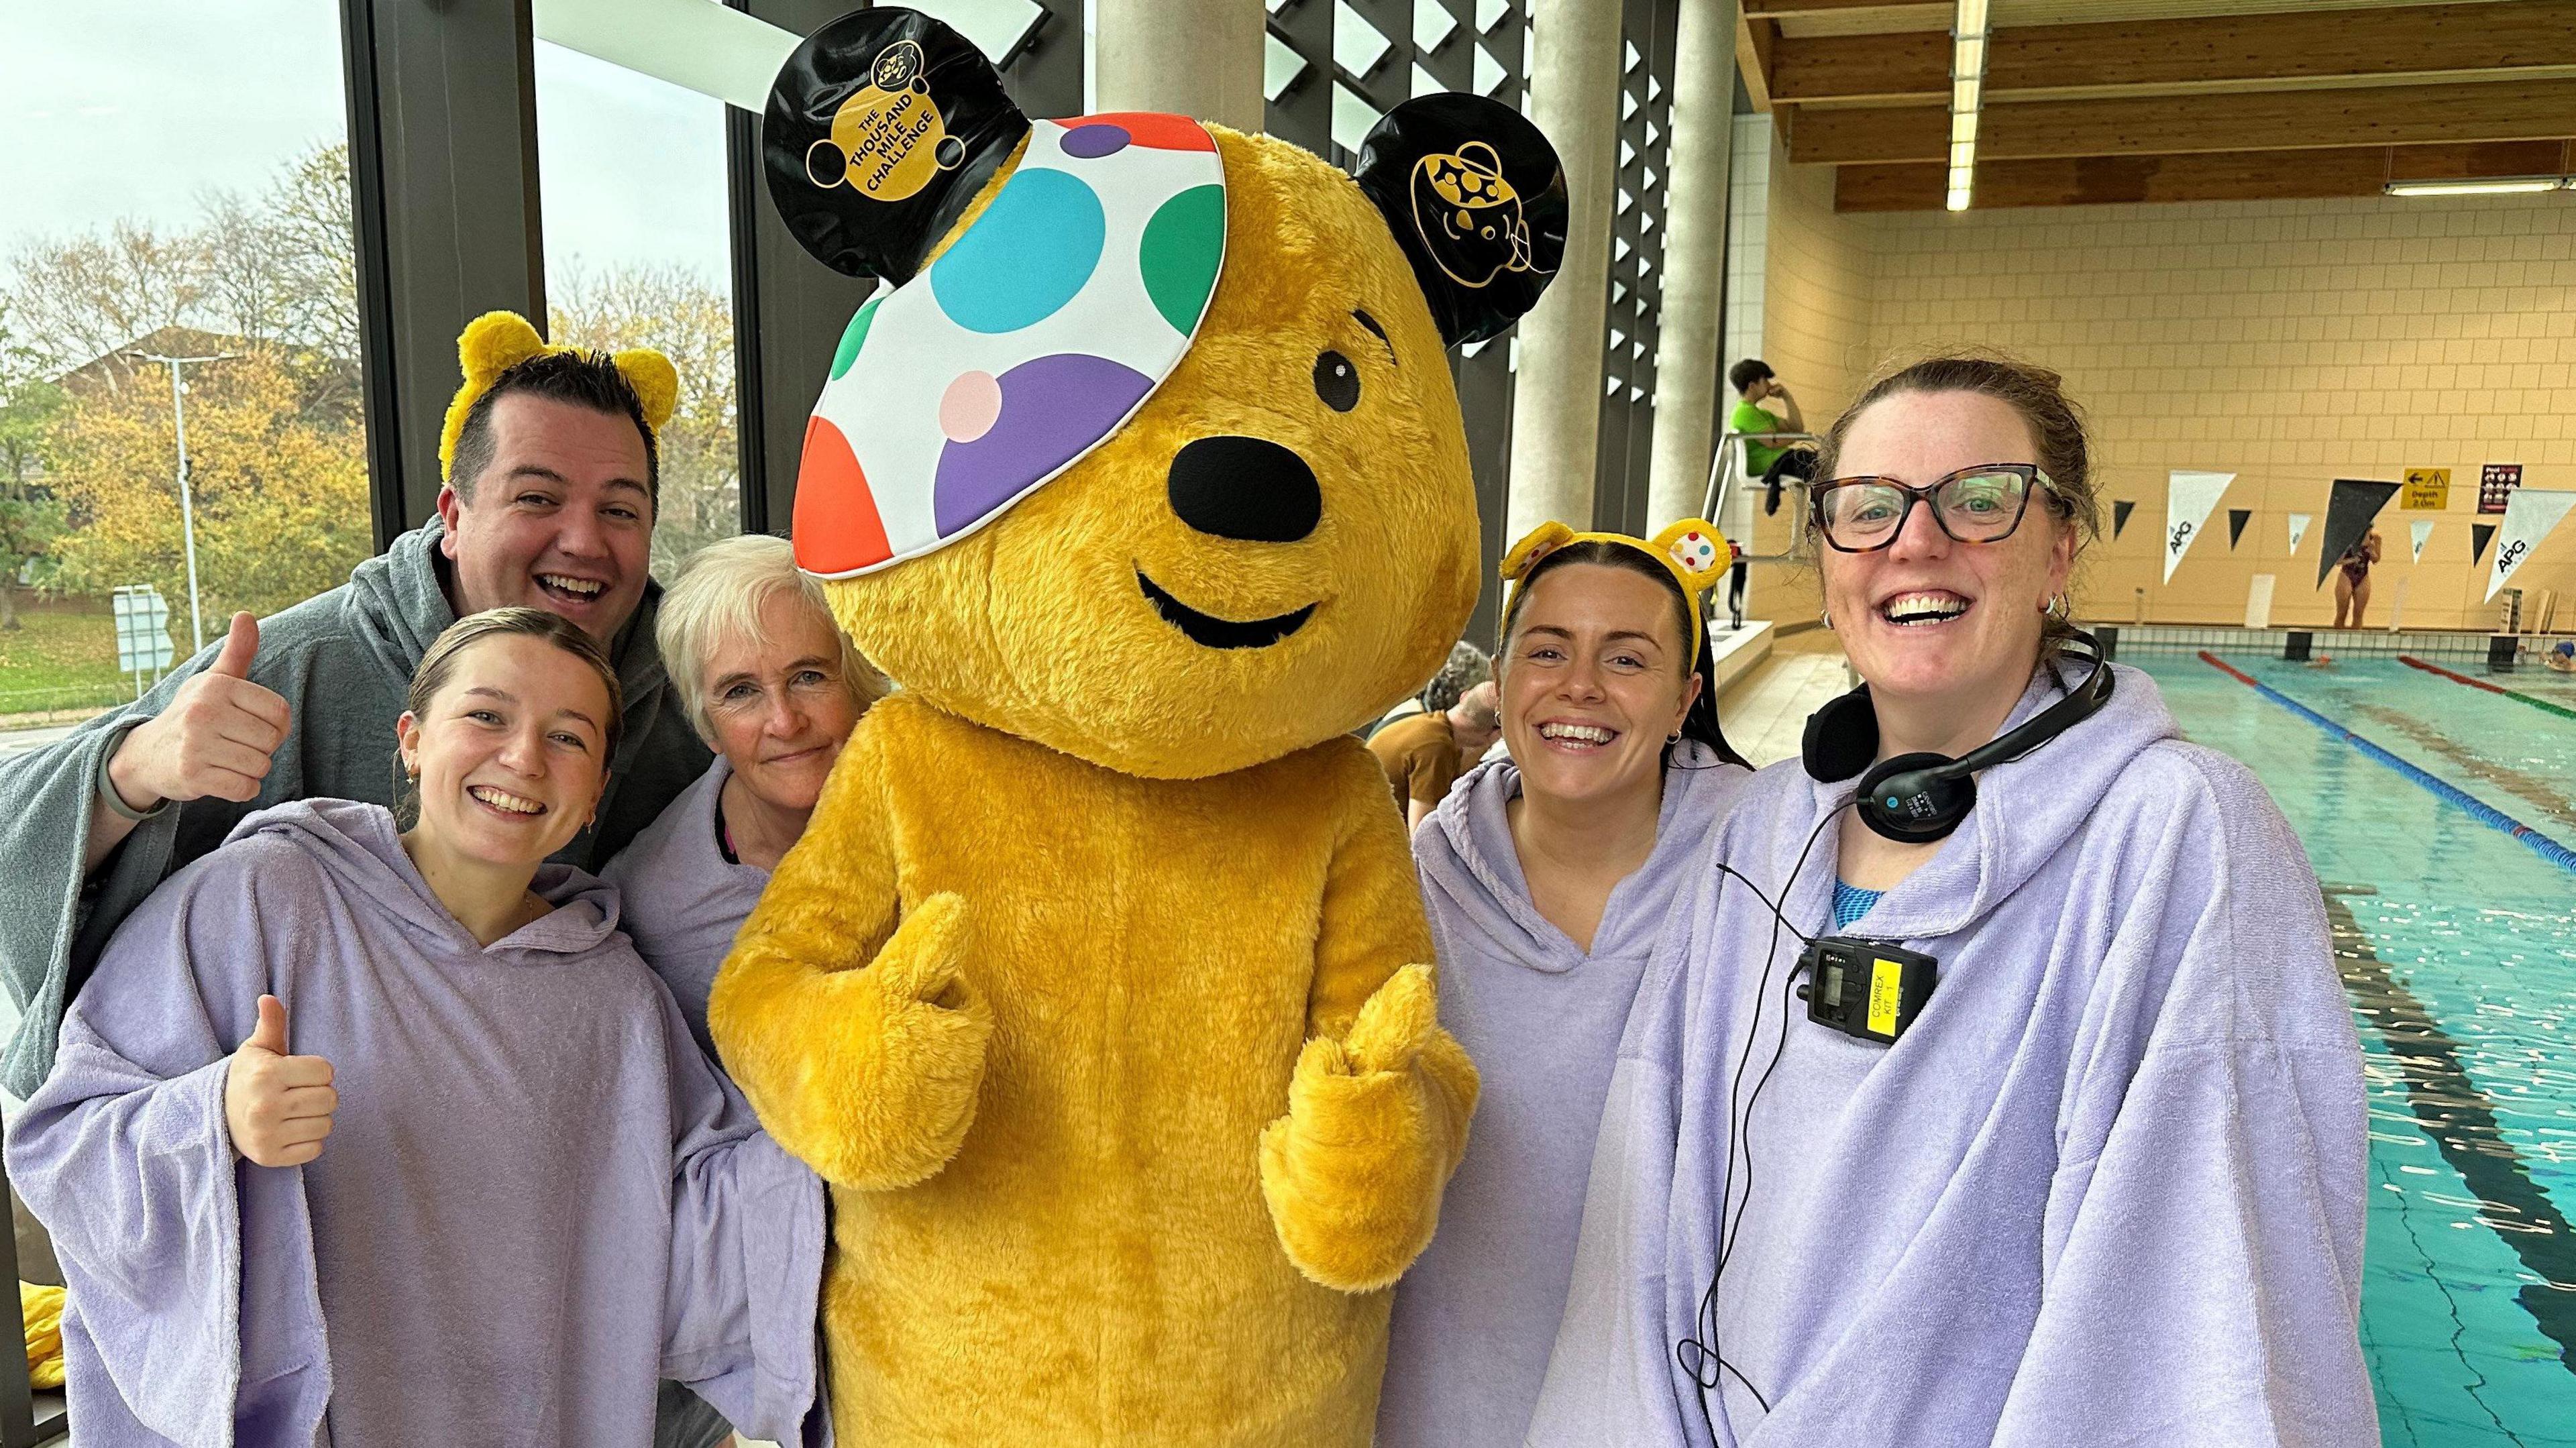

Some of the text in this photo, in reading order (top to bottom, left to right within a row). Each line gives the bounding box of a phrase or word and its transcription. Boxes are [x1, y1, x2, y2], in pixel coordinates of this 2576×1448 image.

[849, 94, 912, 166] THOUSAND
[859, 109, 880, 131] THE
[867, 110, 934, 191] CHALLENGE
[876, 121, 907, 158] MILE
[2412, 490, 2438, 500] Depth
[2170, 520, 2192, 555] APG
[2498, 539, 2526, 573] APG
[1872, 975, 1884, 1017] COMREX
